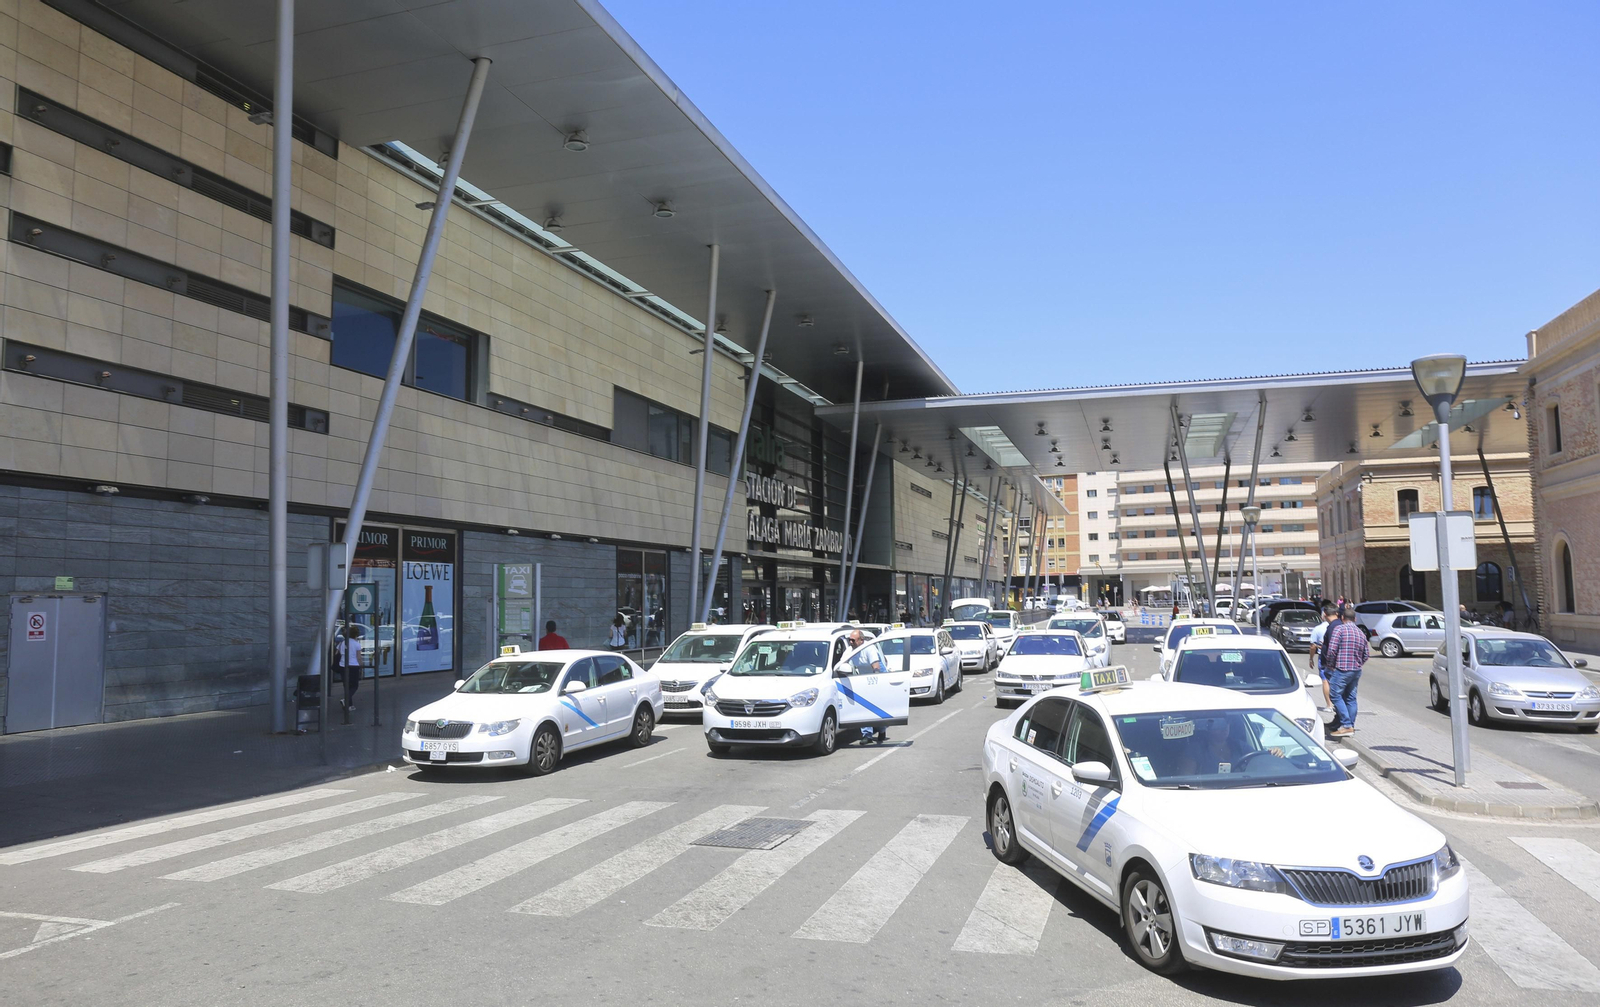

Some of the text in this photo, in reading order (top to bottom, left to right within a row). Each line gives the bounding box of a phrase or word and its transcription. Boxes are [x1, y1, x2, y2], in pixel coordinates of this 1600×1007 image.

[746, 470, 785, 507] STACIÓN
[411, 535, 447, 550] PRIMOR
[784, 519, 813, 550] MARÍA
[815, 525, 852, 555] ZAMBRAO
[406, 562, 450, 581] LOEWE
[503, 566, 530, 575] TAXI
[1223, 653, 1241, 661] LIBRE
[1094, 671, 1116, 684] TAXI
[734, 720, 751, 728] 9596
[753, 720, 767, 728] JXH
[1165, 723, 1192, 737] OCUPADO
[424, 742, 457, 751] 6857 GYS
[1070, 786, 1083, 800] 1203
[1302, 921, 1327, 935] SP
[1343, 917, 1385, 936] 5361
[1393, 913, 1423, 933] JYW
